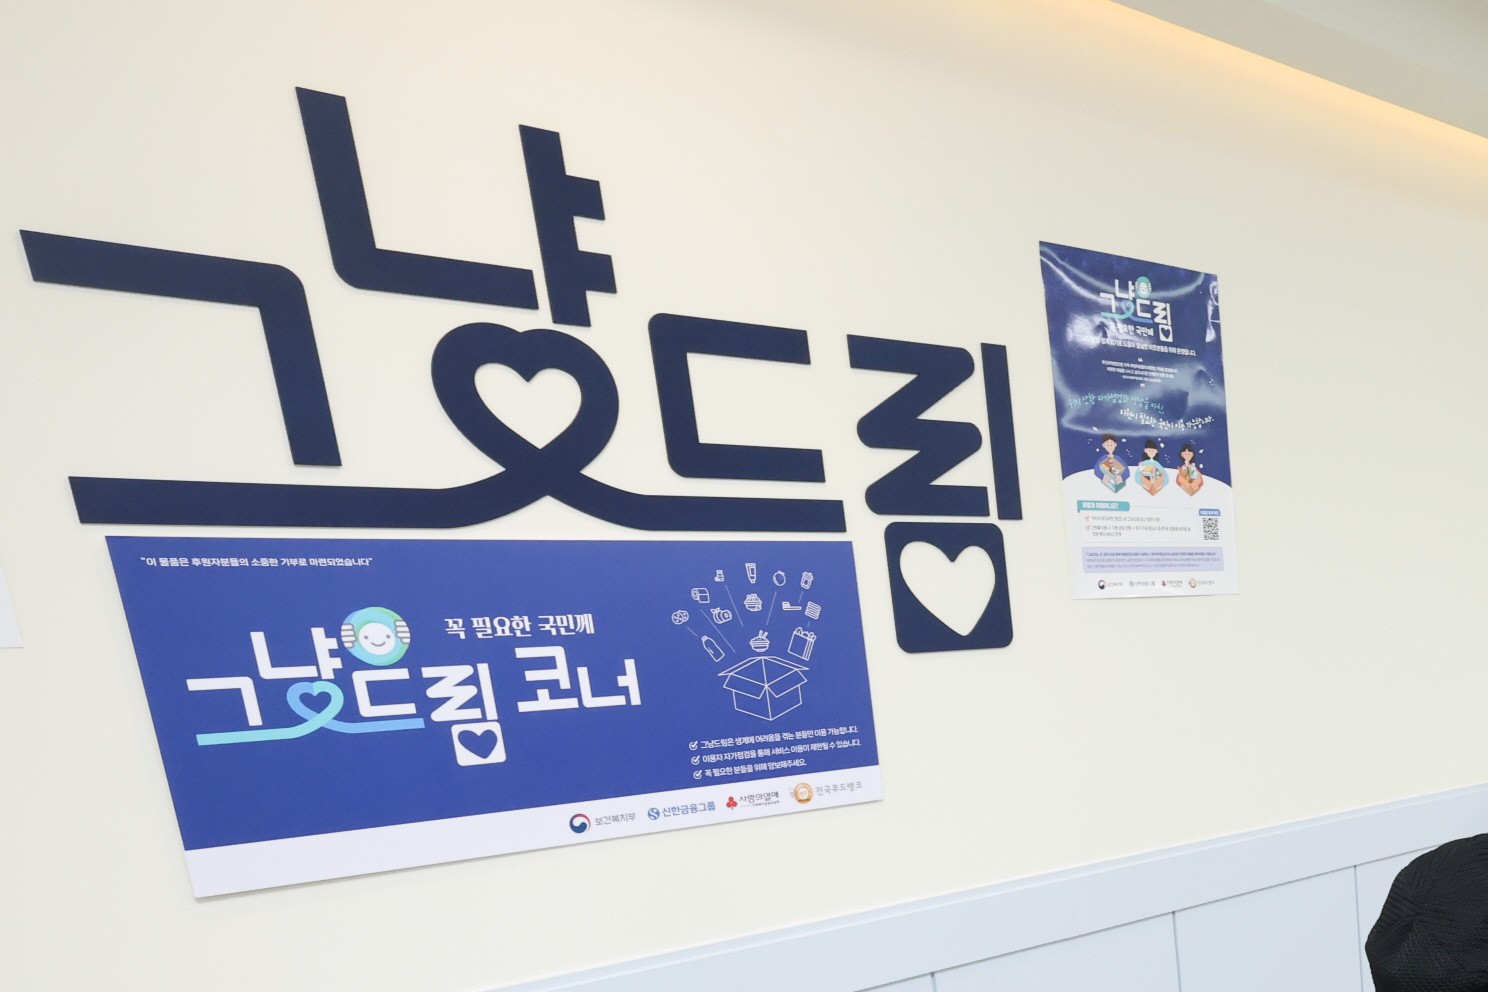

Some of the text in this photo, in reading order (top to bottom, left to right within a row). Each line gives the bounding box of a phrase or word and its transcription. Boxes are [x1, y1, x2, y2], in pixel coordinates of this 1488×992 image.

[191, 557, 249, 567] 후원자분들의
[251, 557, 279, 567] 소중한
[280, 557, 308, 567] 기부로
[444, 613, 596, 640] 꼭 필요한 국민께
[186, 626, 642, 767] 그냥드림 코너
[662, 801, 717, 818] 신한금융그룹
[815, 781, 863, 797] 전국푸드뱅크
